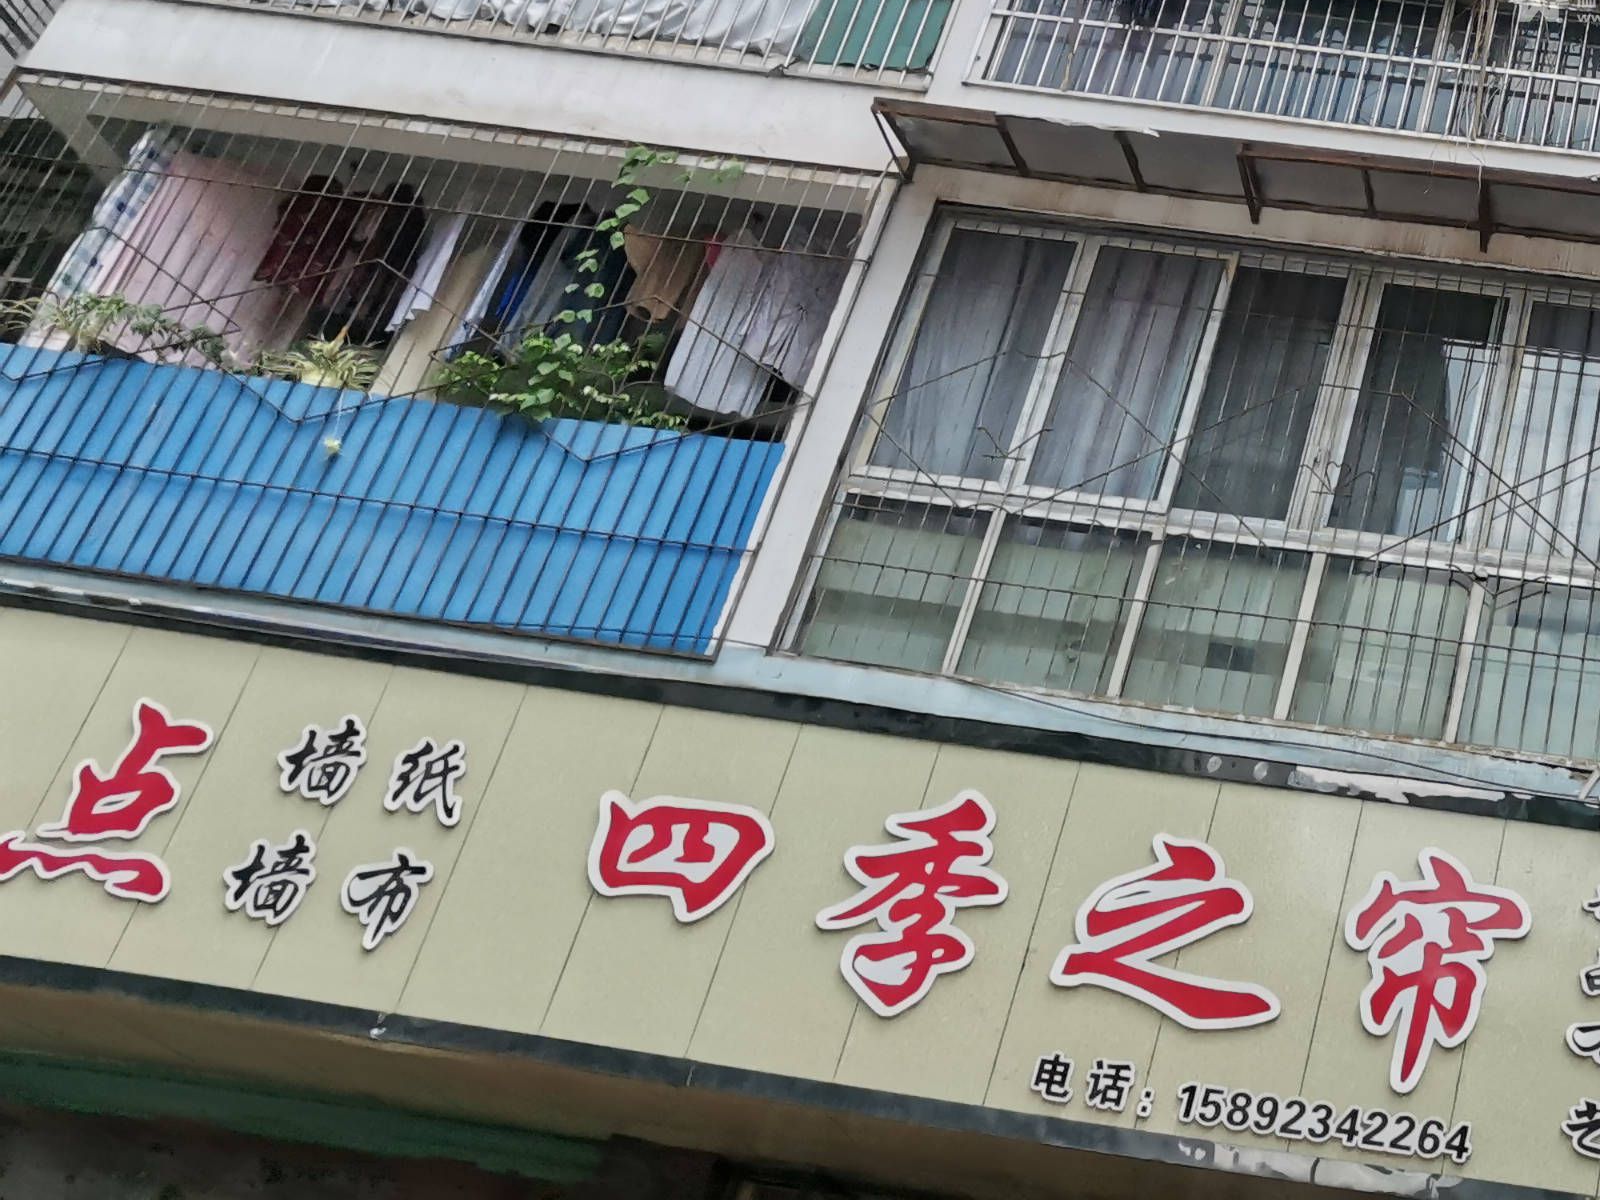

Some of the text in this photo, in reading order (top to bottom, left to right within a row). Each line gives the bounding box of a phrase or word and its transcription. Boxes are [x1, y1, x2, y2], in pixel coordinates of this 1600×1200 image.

[279, 714, 467, 827] 墙纸
[224, 830, 434, 952] 墙布
[588, 788, 1532, 1095] 四季之帘
